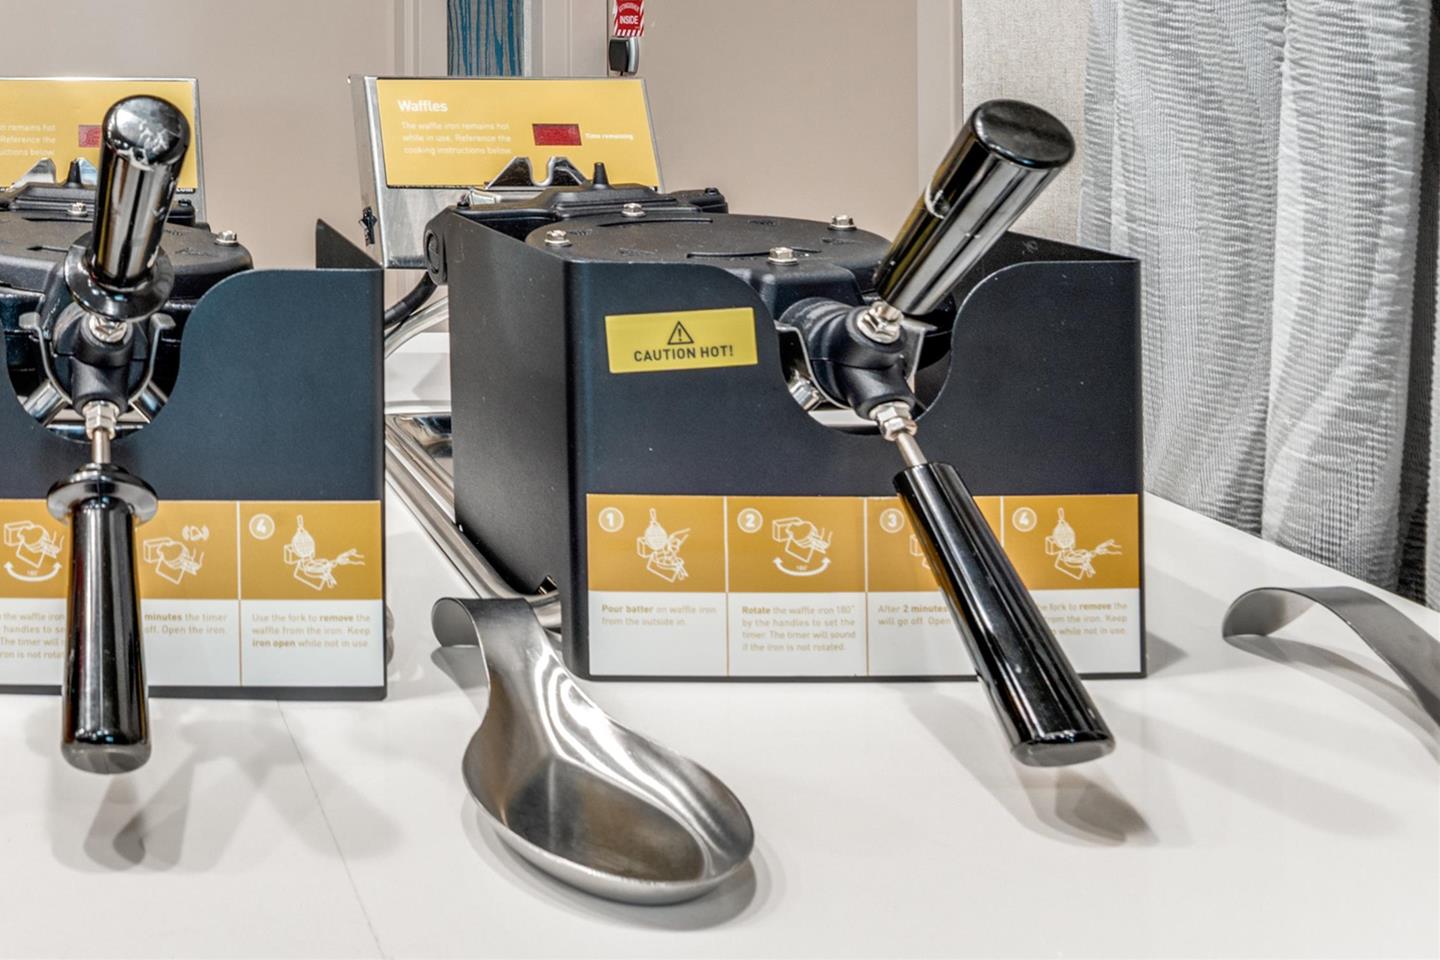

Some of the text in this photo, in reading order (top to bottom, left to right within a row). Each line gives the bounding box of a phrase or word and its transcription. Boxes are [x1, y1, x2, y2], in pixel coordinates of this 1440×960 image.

[398, 100, 448, 112] Waffles
[634, 345, 733, 362] CAUTION HOT!
[606, 513, 614, 526] 1
[745, 514, 755, 527] 2
[887, 514, 897, 528] 3
[1019, 513, 1029, 526] 4
[256, 520, 266, 533] 4
[601, 604, 623, 613] Pour
[626, 604, 654, 613] batter
[742, 606, 770, 614] Rotate
[903, 605, 909, 613] 2
[911, 605, 948, 613] minutes
[1079, 603, 1112, 611] remove
[144, 613, 183, 622] minutes
[320, 614, 354, 622] remove
[55, 625, 65, 633] se
[252, 639, 271, 647] iron
[273, 641, 296, 649] open
